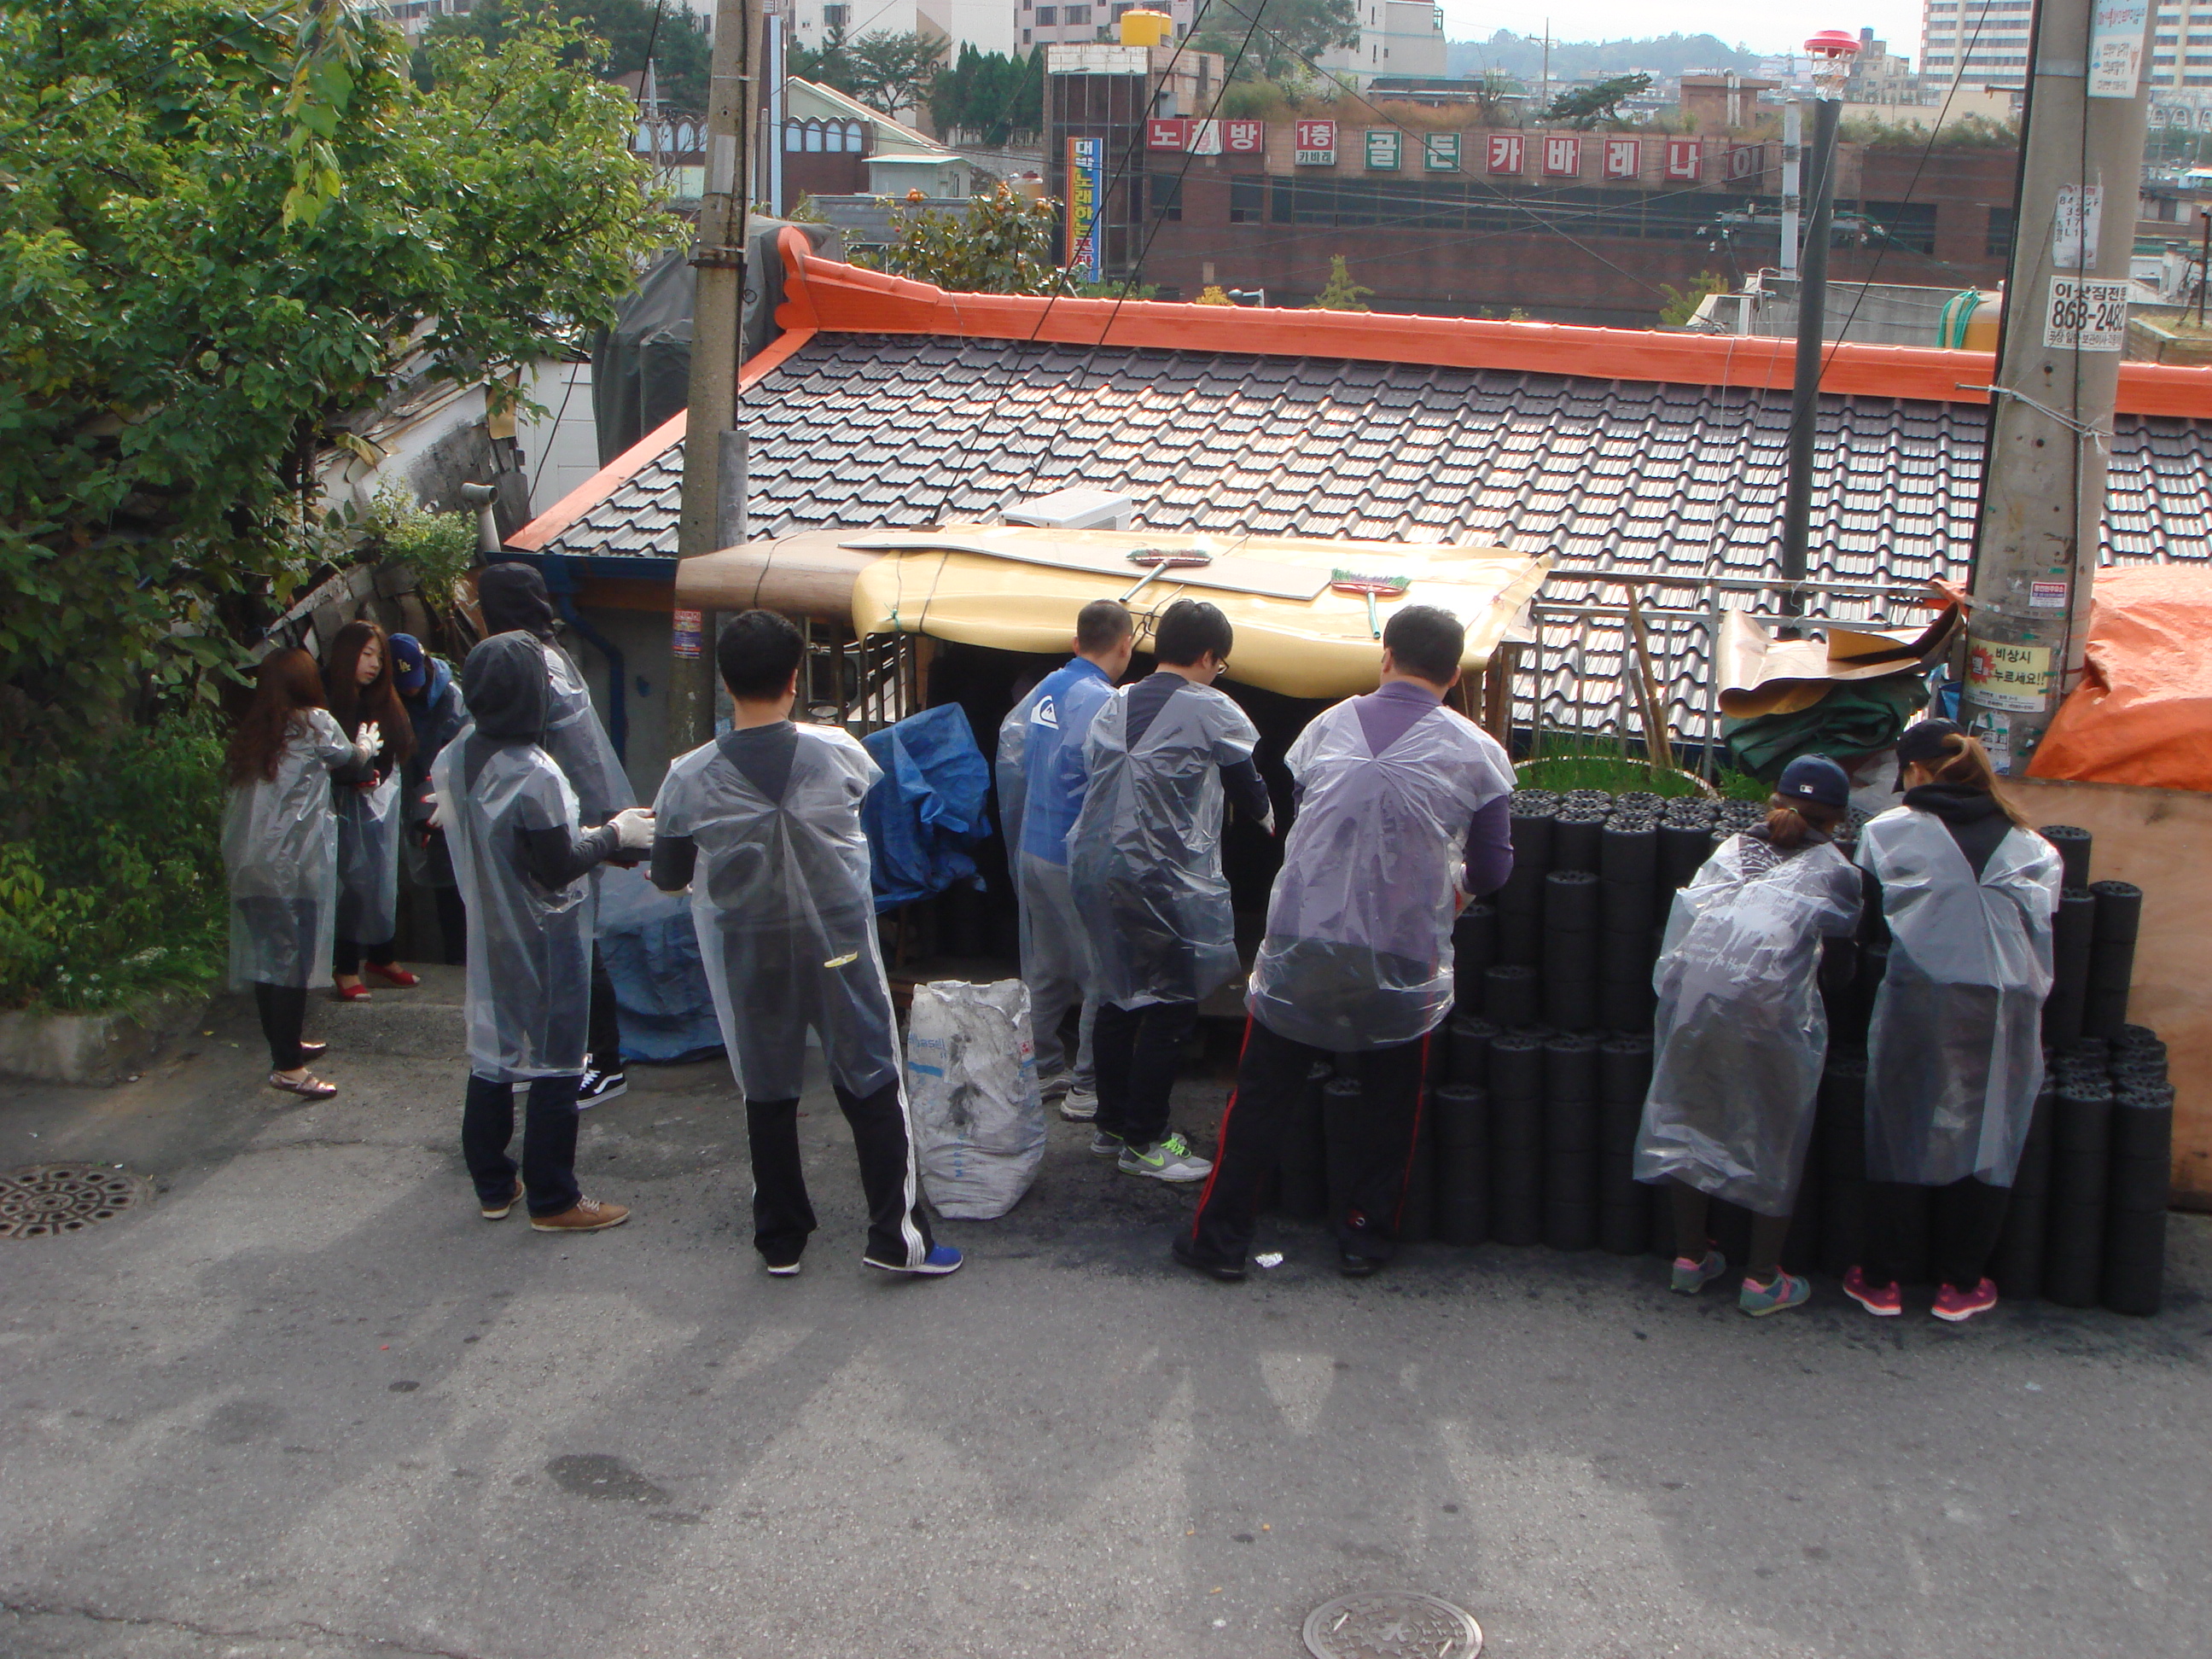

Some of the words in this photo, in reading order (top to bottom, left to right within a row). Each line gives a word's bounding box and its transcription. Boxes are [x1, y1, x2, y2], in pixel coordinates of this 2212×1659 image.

[1151, 124, 1258, 150] 노방
[1299, 125, 1331, 147] 1층
[1298, 150, 1333, 163] 카바레
[1368, 133, 1458, 168] 골든
[1492, 137, 1634, 178] 카바레
[1995, 648, 2031, 665] 비상시
[1994, 669, 2045, 685] 누르세요!!
